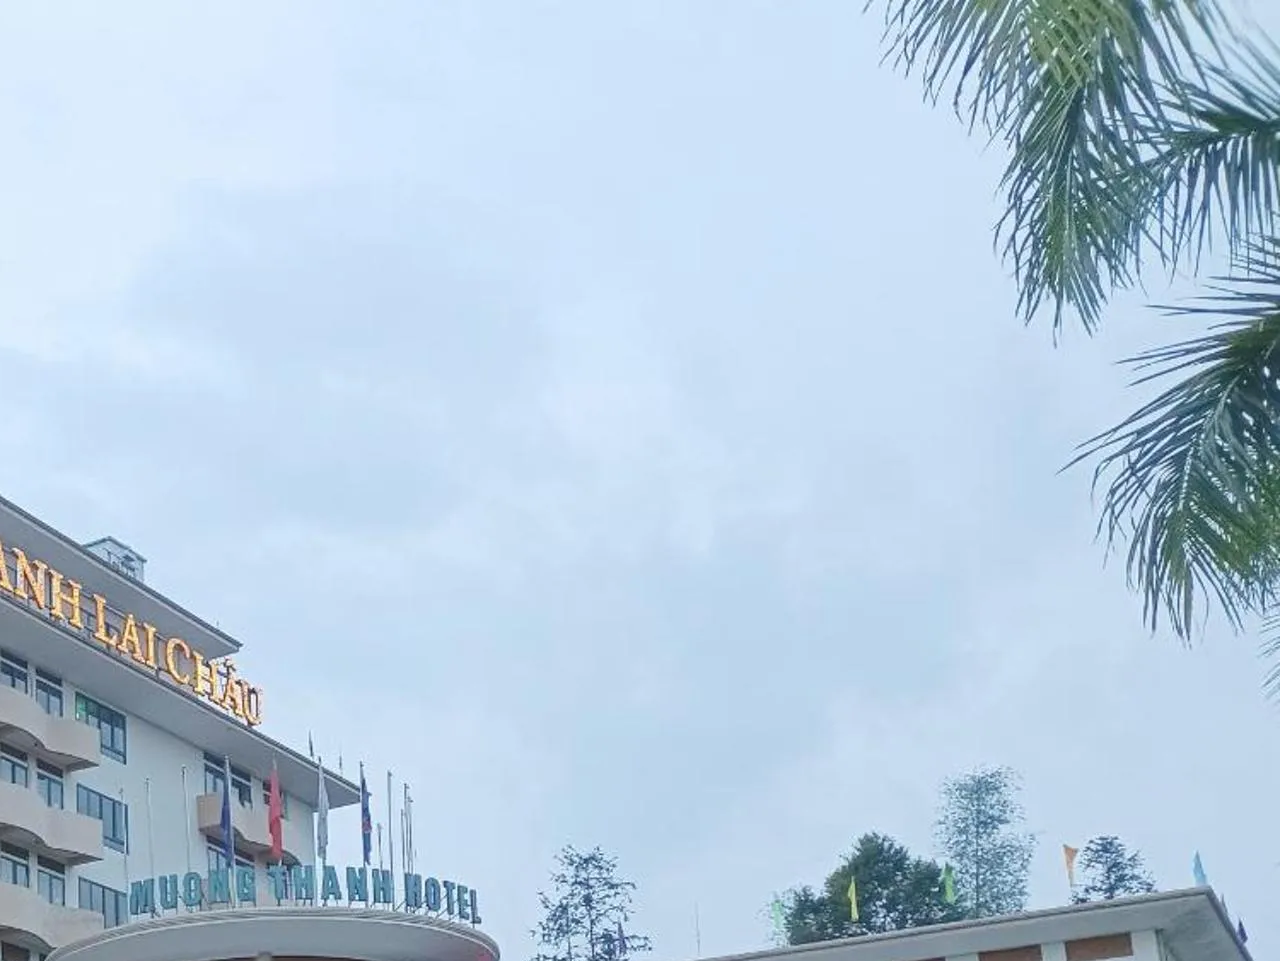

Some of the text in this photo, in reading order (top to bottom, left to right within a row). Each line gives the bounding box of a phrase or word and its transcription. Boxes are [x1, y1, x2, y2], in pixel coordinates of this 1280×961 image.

[92, 592, 158, 668] LAI
[165, 655, 263, 727] CHÂU
[130, 864, 482, 924] MUONG THANH HOTEL
